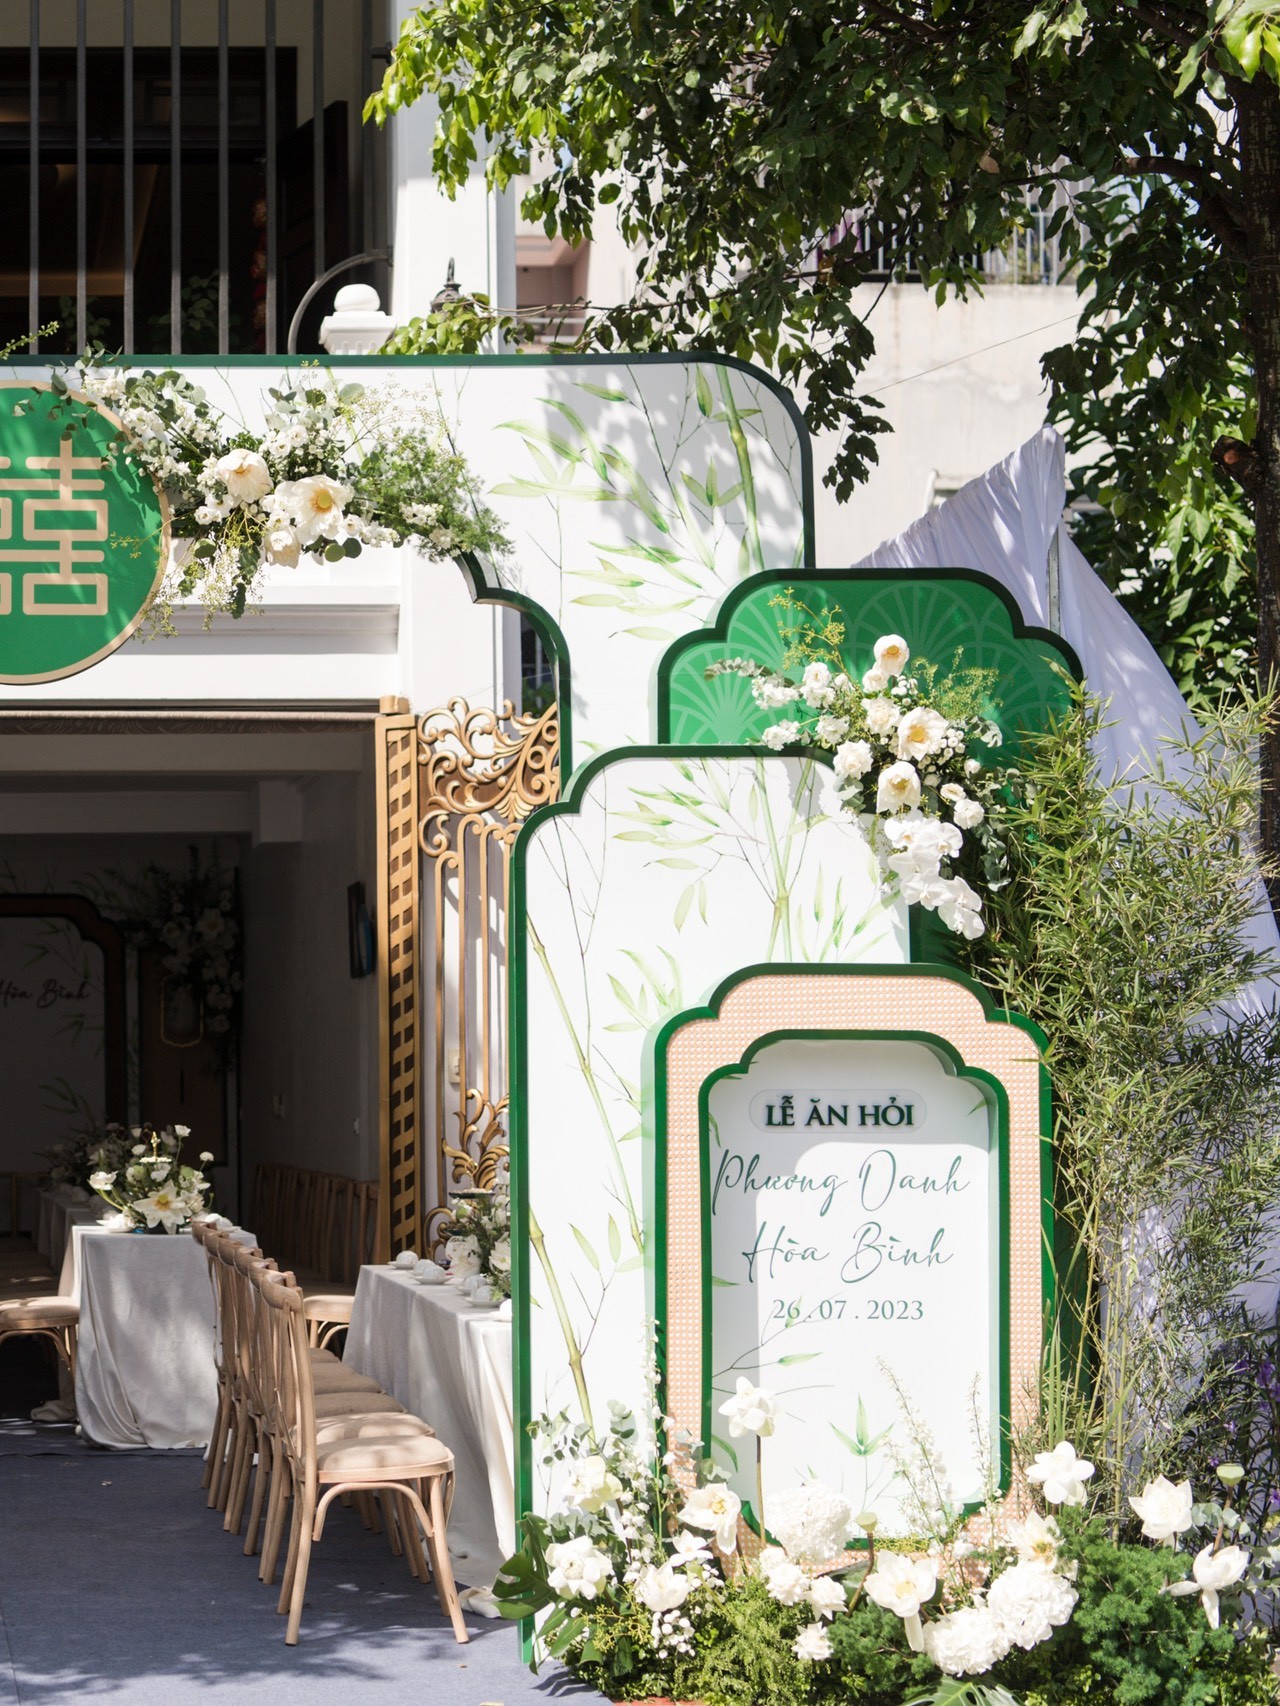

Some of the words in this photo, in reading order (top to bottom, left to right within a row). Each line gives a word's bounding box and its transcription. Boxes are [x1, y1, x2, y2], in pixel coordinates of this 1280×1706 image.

[765, 1095, 795, 1127] LỄ
[804, 1098, 850, 1127] ĂN
[858, 1095, 915, 1127] HỎI
[711, 1148, 849, 1217] Phương
[741, 1220, 830, 1284] Hòa
[840, 1221, 954, 1284] Bình
